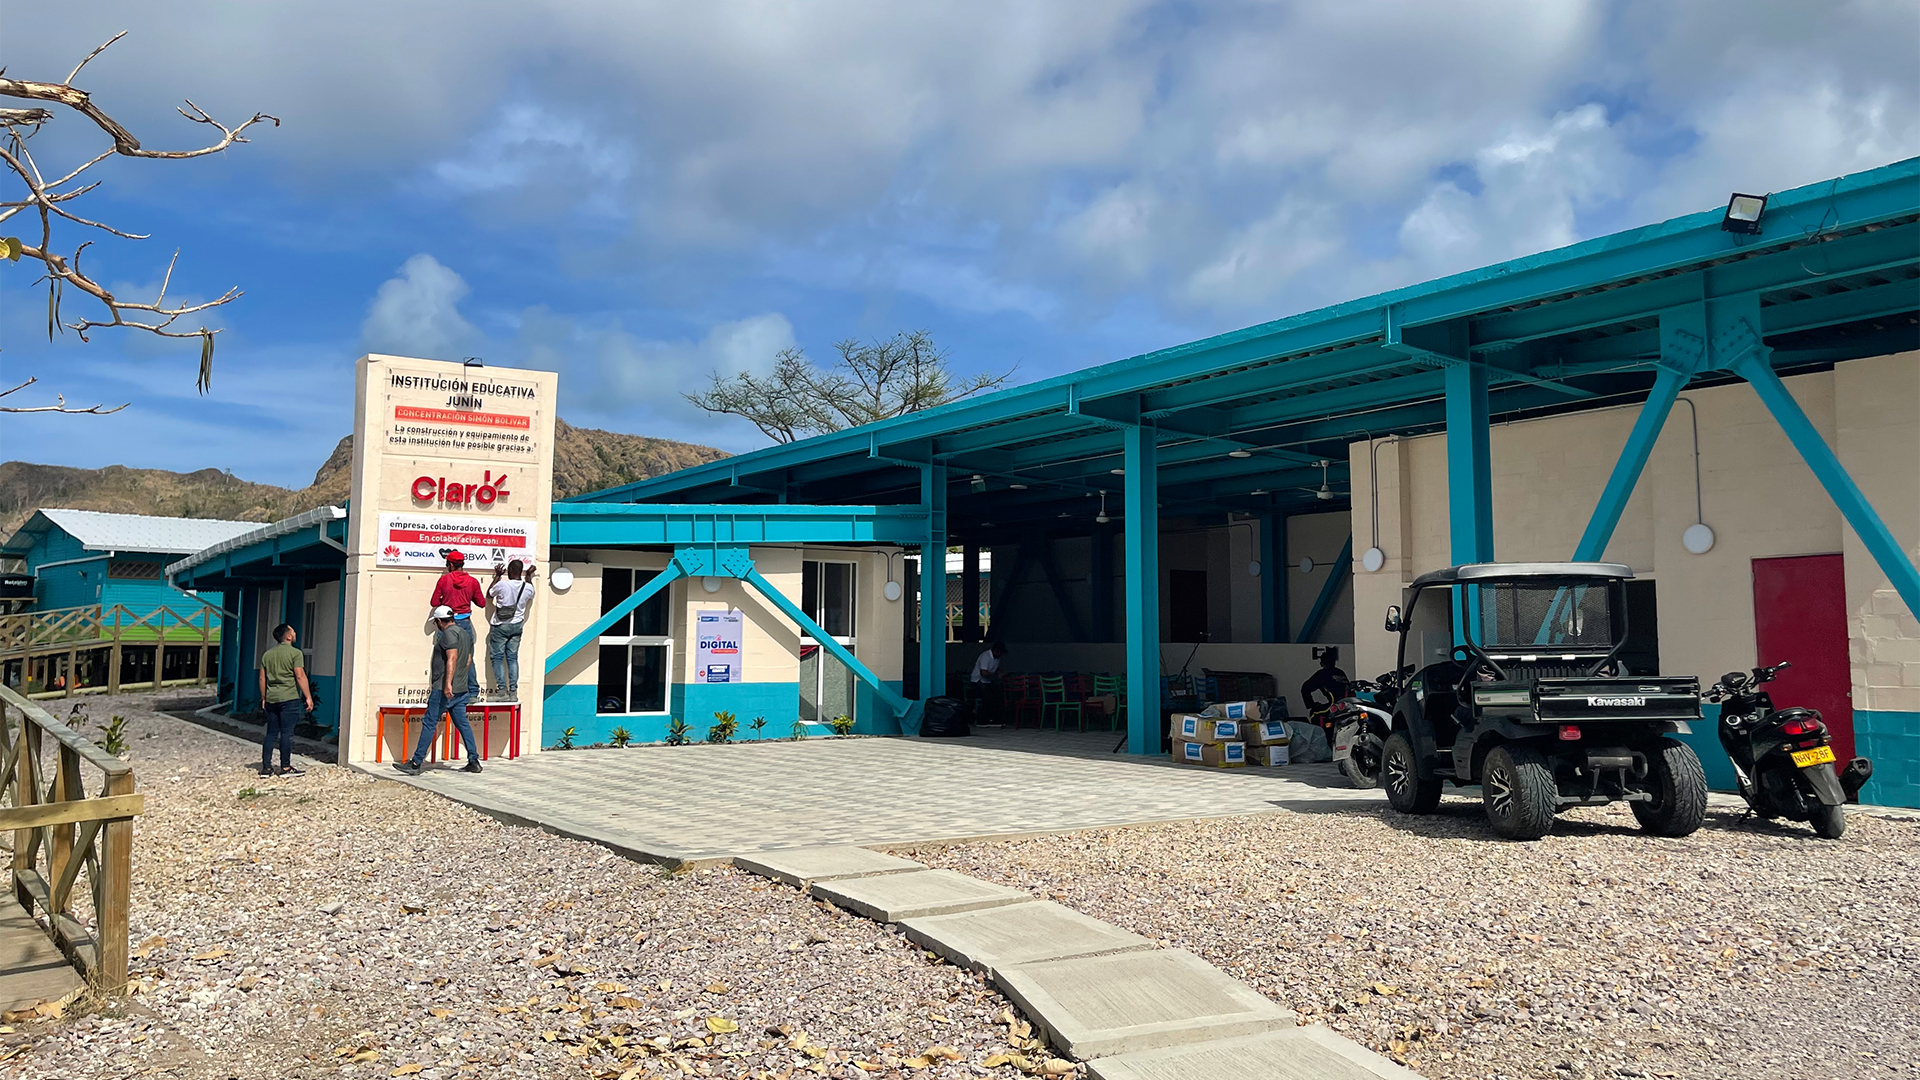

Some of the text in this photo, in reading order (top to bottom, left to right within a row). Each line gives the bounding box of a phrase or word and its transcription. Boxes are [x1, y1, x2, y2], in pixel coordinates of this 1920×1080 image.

[391, 374, 535, 398] INSTITUCIÓN EDUCATIVA
[446, 395, 482, 408] JUNÍN
[397, 408, 466, 421] CONCENTRACIÓN
[467, 414, 493, 424] SIMÓN
[395, 424, 530, 442] La construcción y equipamiento de
[409, 437, 451, 446] institución
[452, 439, 465, 447] fue
[467, 440, 495, 450] posible
[497, 444, 525, 453] gracias
[412, 474, 499, 504] Claro
[389, 521, 428, 530] empresa,
[430, 523, 487, 533] colaboradores
[494, 526, 527, 535] clientes.
[419, 533, 430, 541] En
[431, 534, 481, 544] colaboración
[700, 641, 738, 649] DIGITAL
[397, 686, 406, 694] El
[1587, 696, 1646, 707] Kawasaki
